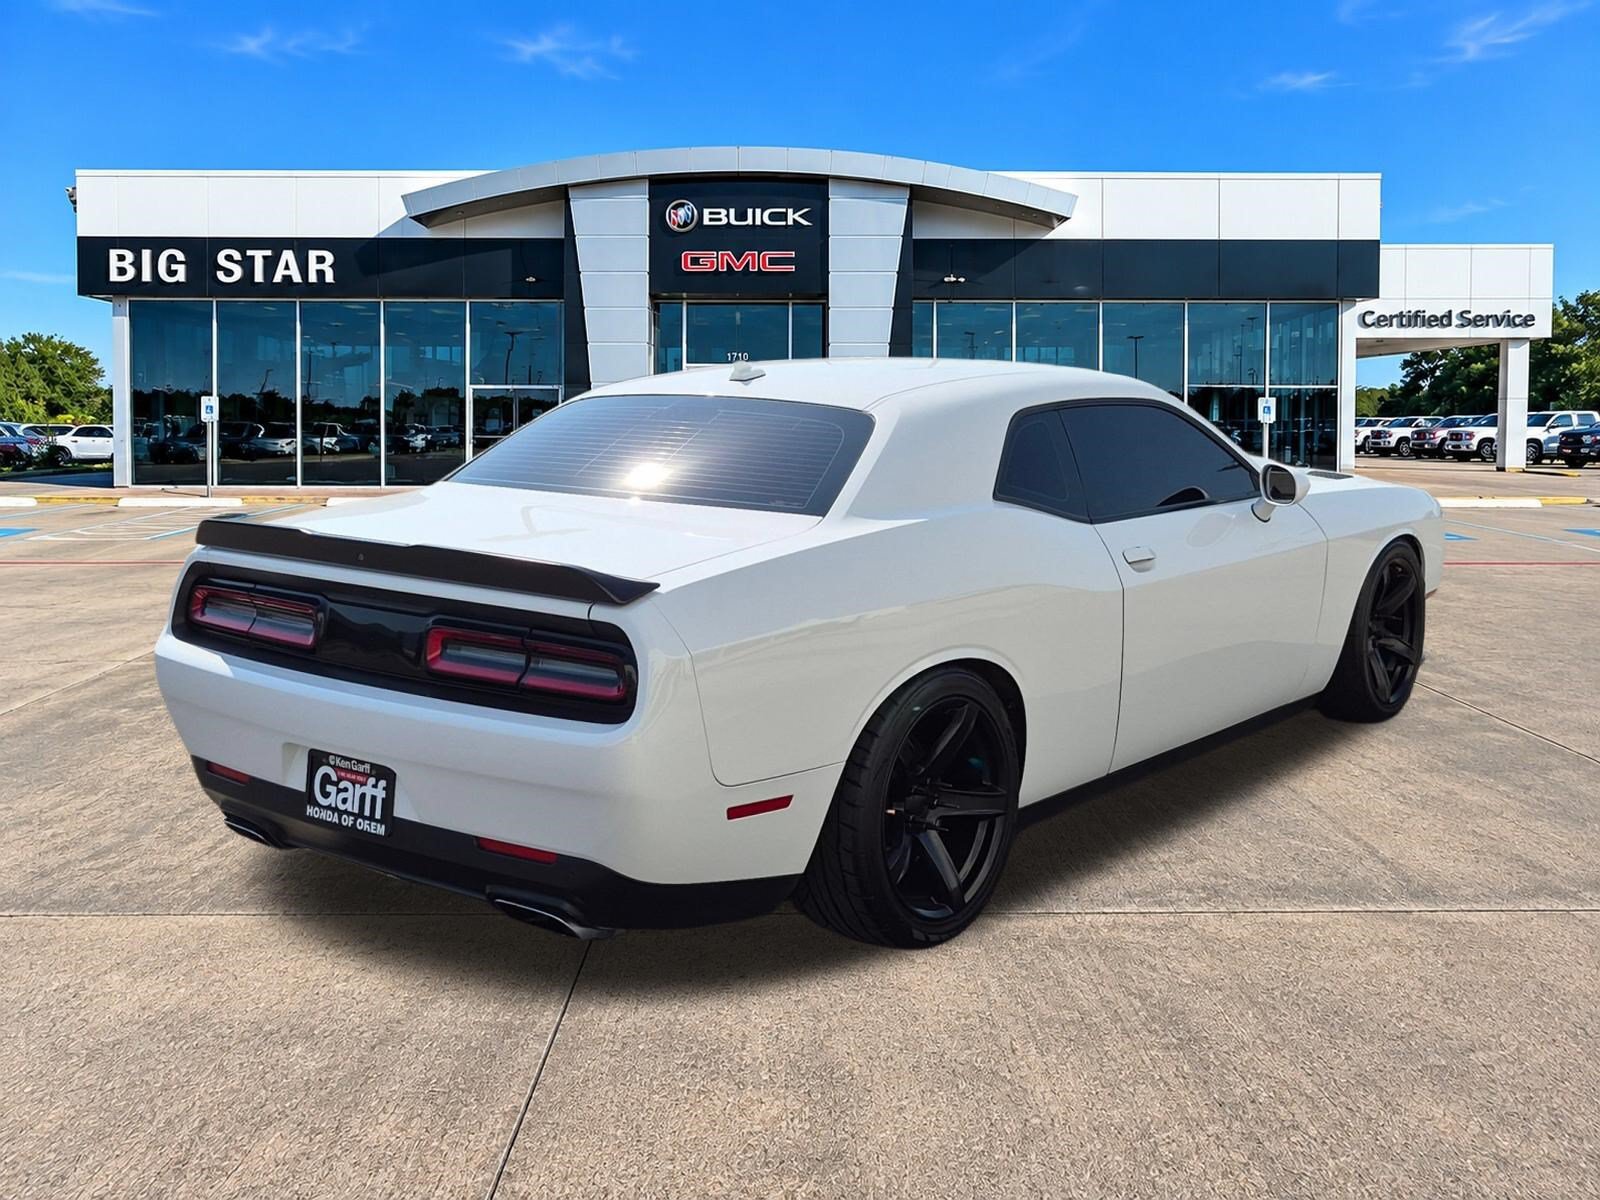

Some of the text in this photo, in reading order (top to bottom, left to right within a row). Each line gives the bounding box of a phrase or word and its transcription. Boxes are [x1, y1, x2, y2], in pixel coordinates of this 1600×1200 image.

[702, 207, 813, 226] BUICK
[108, 248, 336, 284] BIG STAR
[681, 250, 796, 272] GMC
[1358, 309, 1536, 329] Certified Service
[727, 352, 749, 361] 1710
[335, 755, 371, 774] Ken Garff
[313, 765, 387, 819] Garff
[306, 804, 386, 836] HONDA OF OREM
